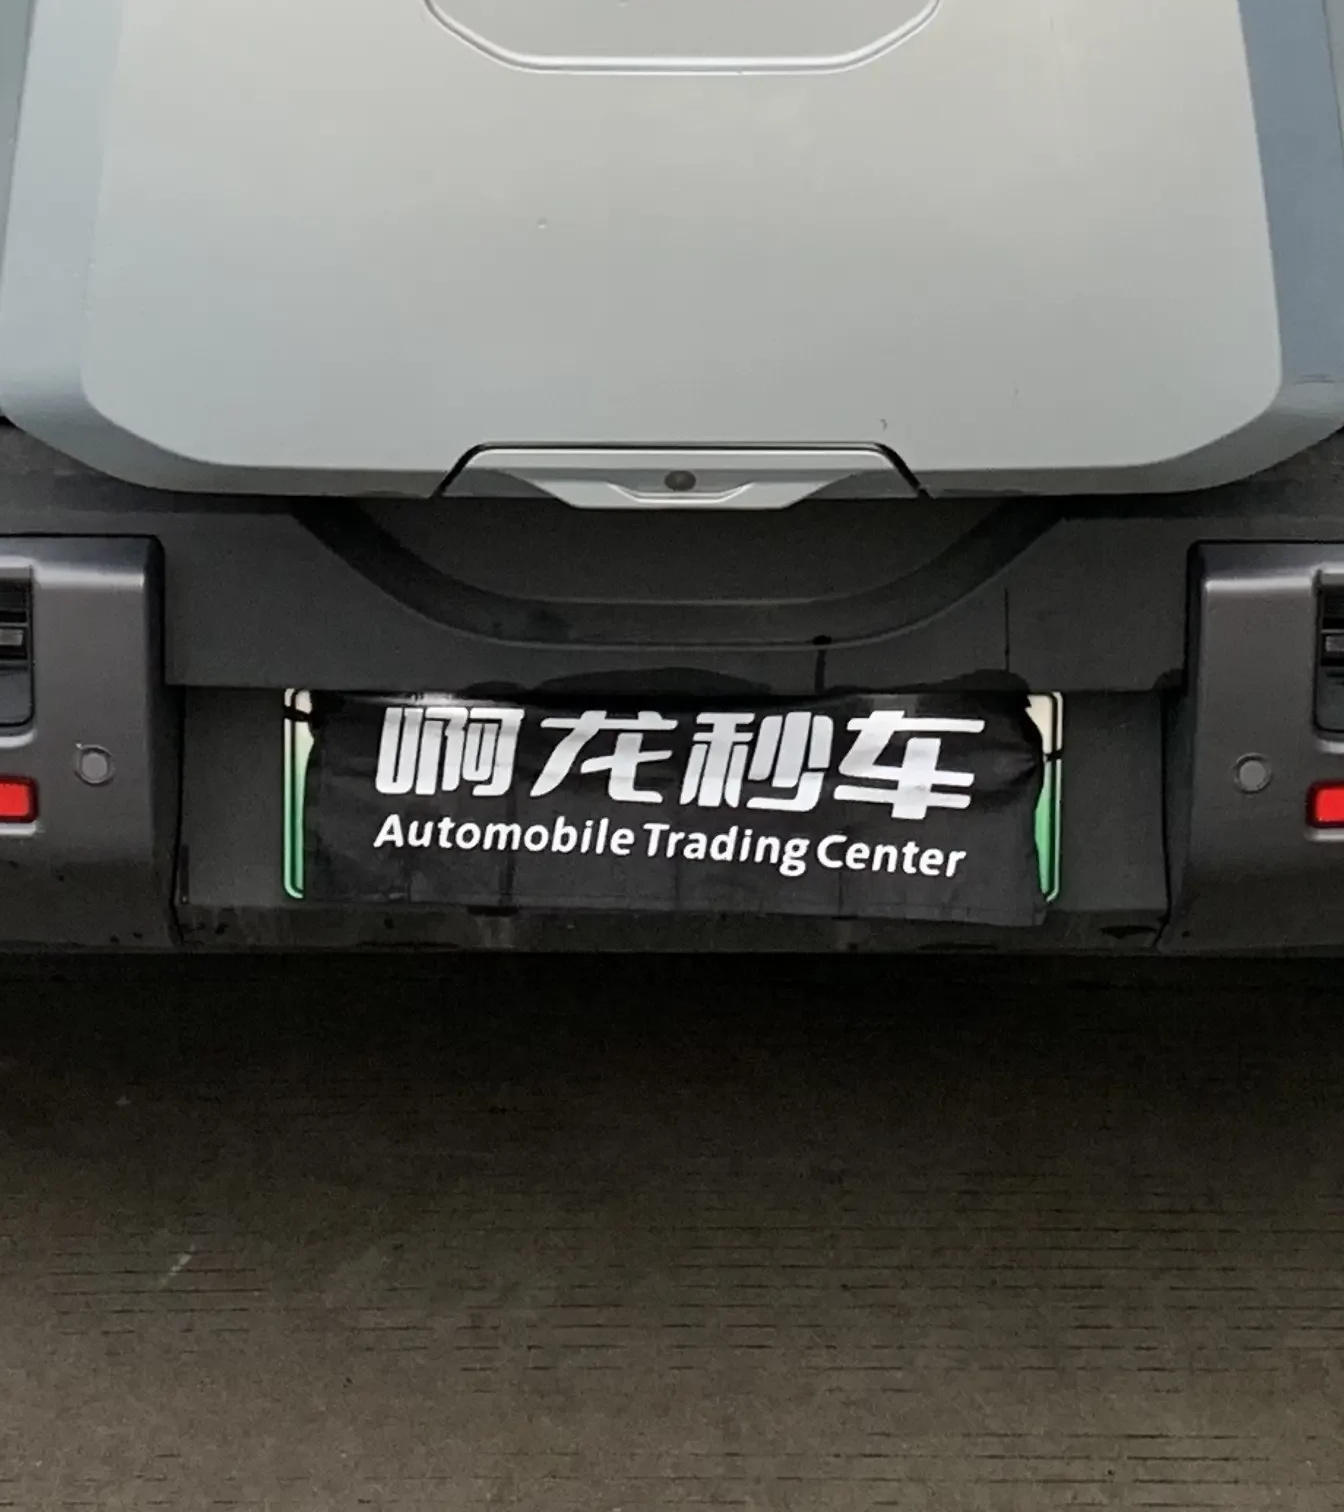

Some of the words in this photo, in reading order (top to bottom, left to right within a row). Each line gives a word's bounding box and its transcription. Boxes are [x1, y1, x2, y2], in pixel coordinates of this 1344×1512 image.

[375, 706, 986, 819] 啊龙秒车
[373, 813, 635, 857] Automobile
[644, 822, 810, 877] Trading
[817, 834, 967, 878] Center
